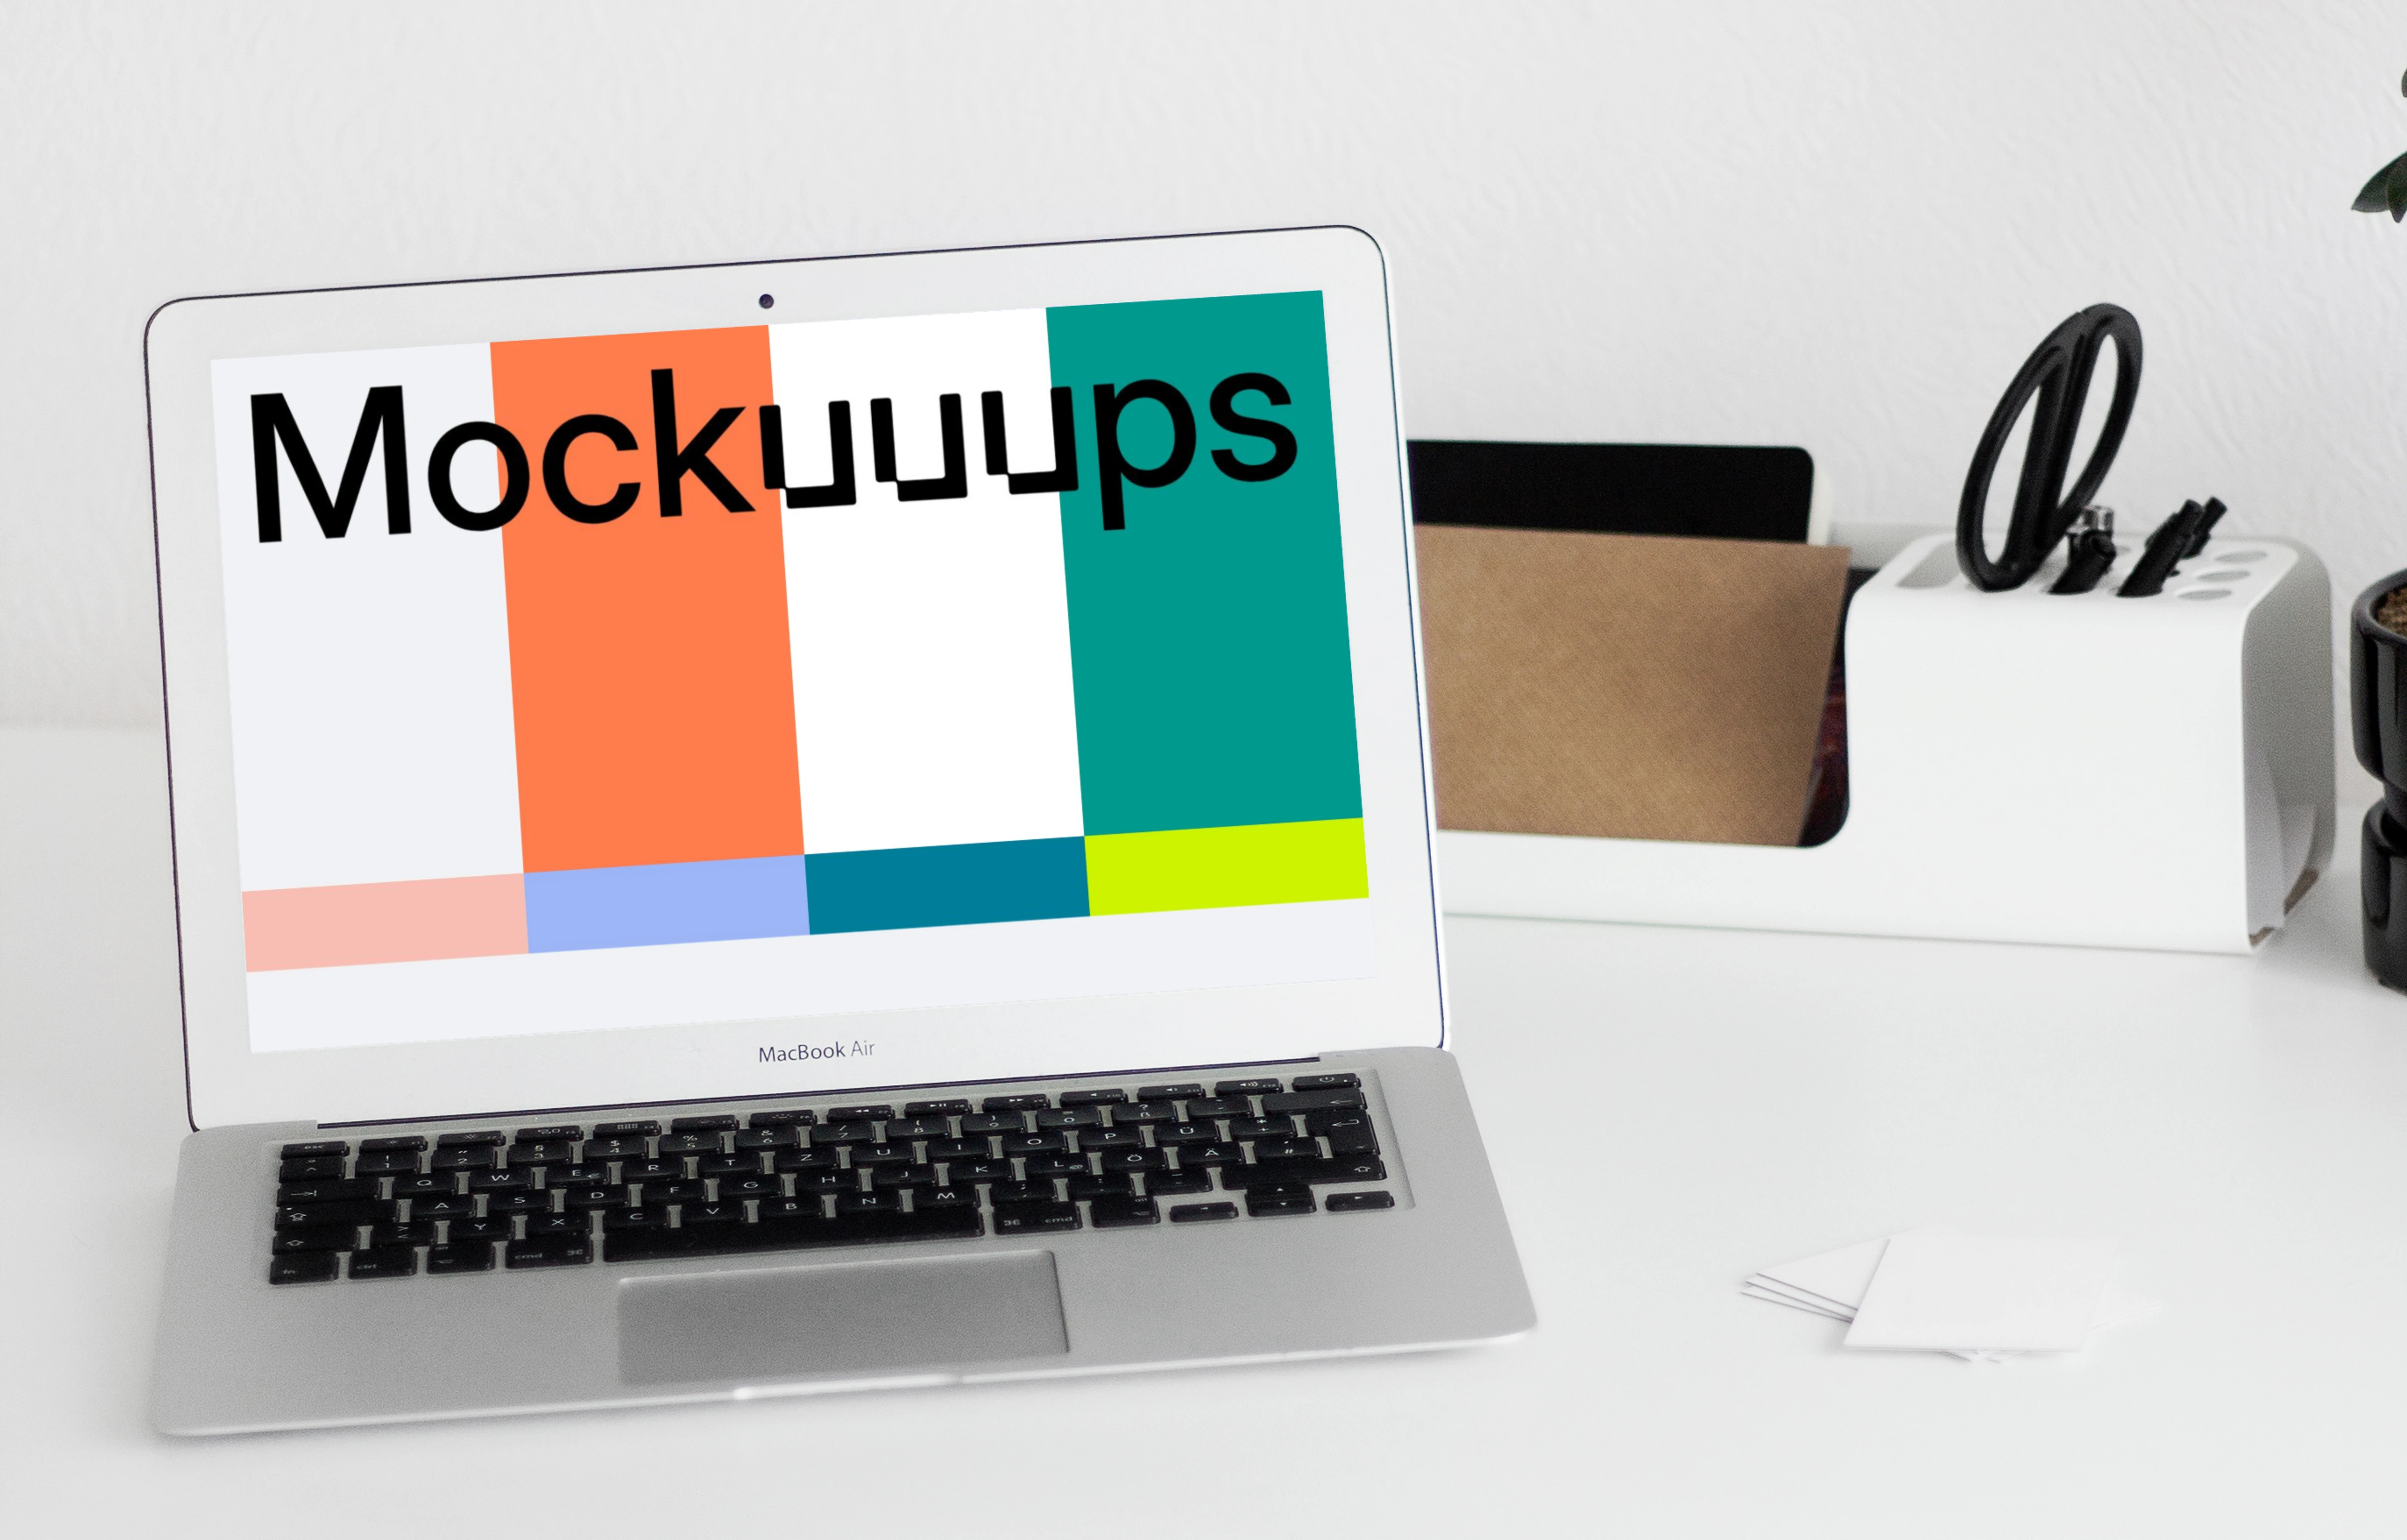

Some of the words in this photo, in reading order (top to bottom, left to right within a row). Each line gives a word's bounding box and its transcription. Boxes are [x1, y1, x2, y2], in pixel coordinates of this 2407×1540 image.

[251, 369, 1297, 542] Mockuuups
[759, 1041, 846, 1063] MacBook
[851, 1040, 875, 1057] Air
